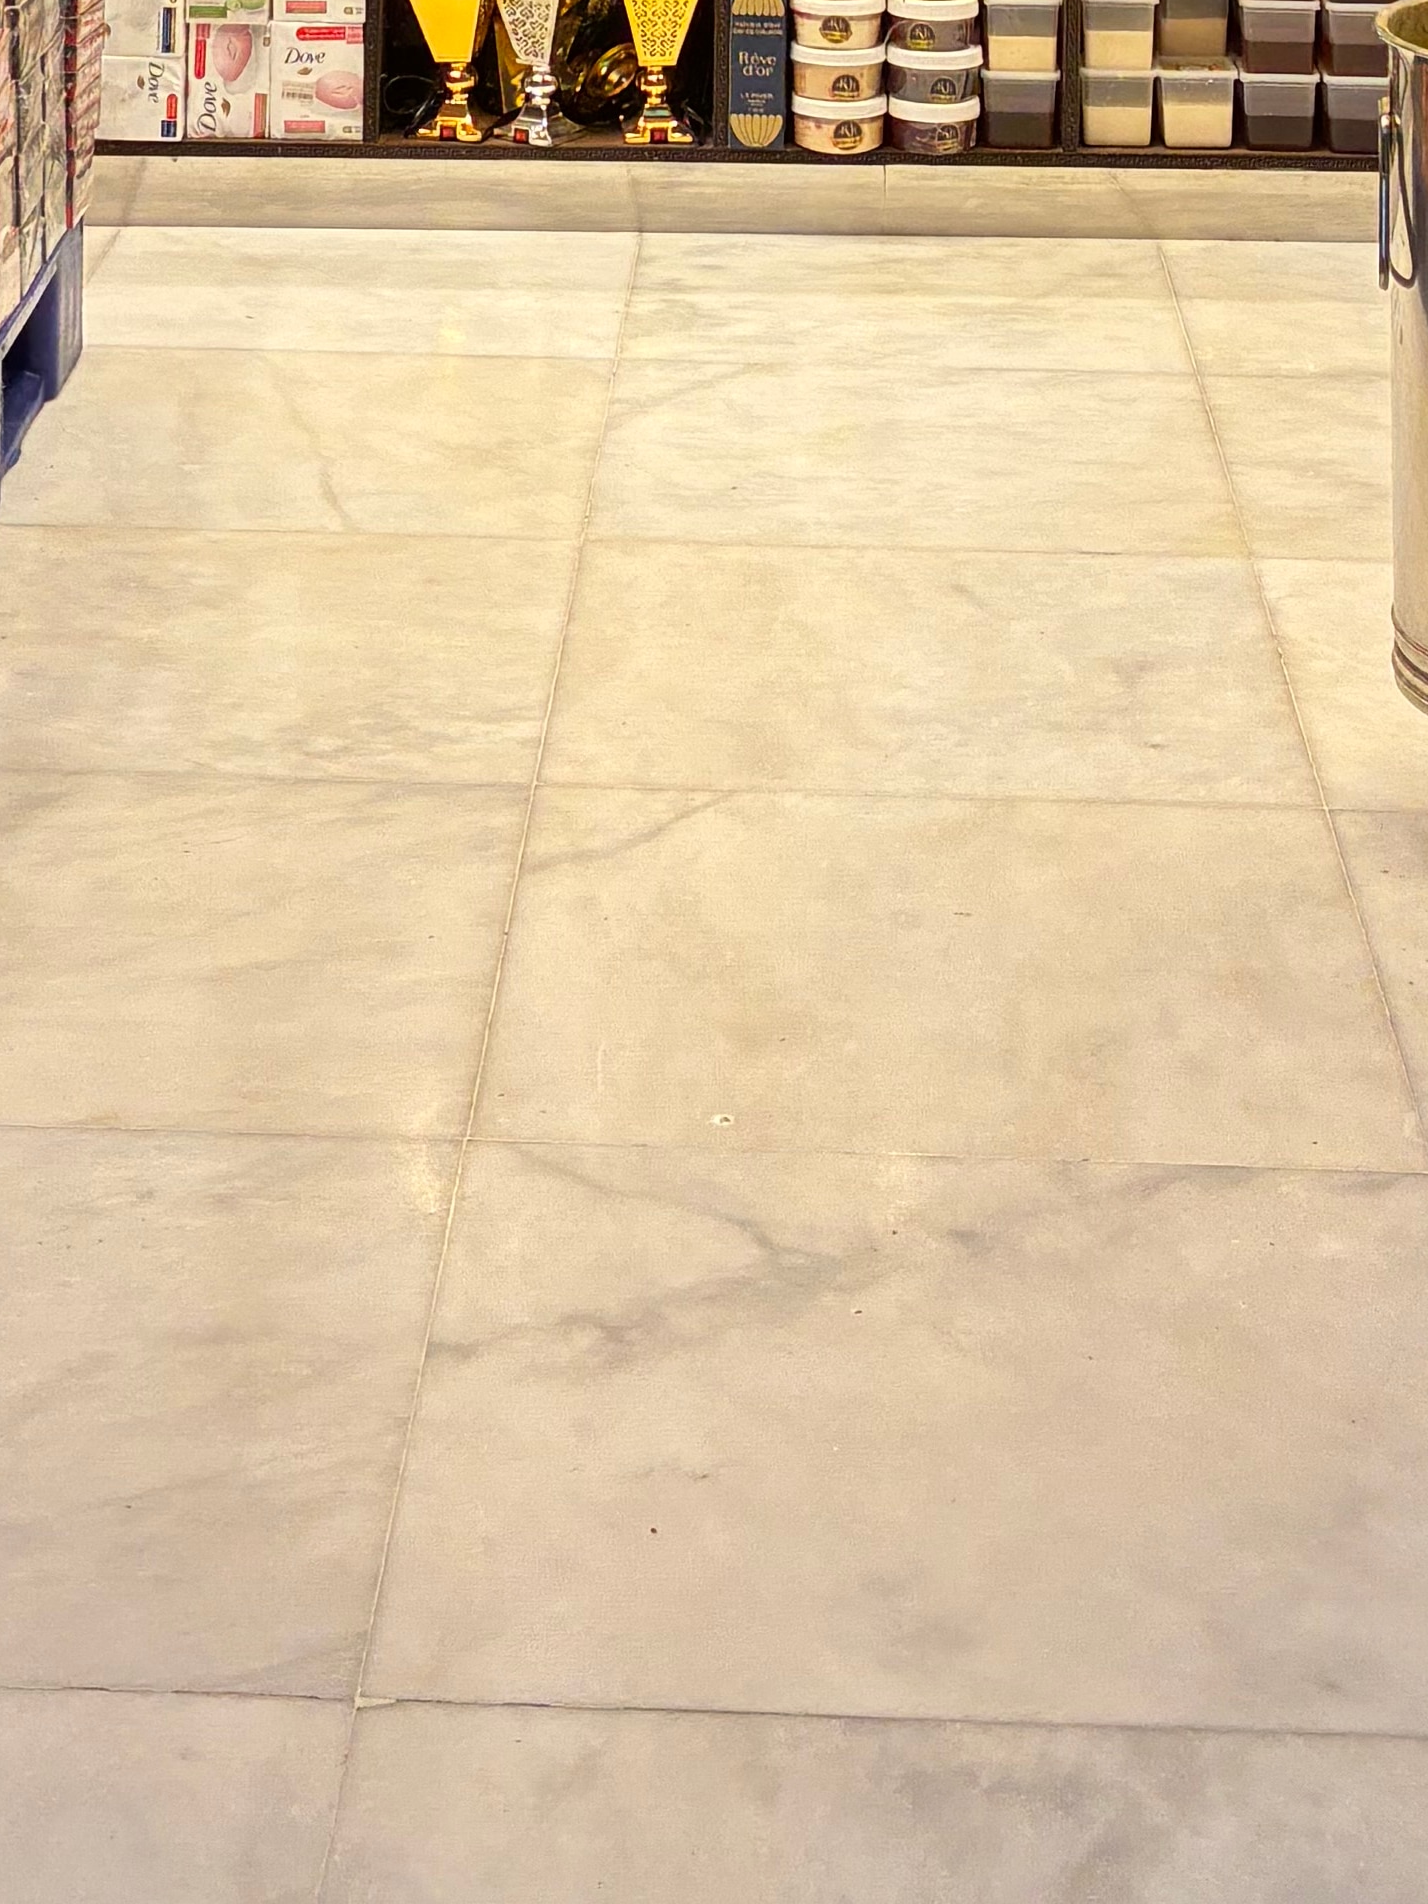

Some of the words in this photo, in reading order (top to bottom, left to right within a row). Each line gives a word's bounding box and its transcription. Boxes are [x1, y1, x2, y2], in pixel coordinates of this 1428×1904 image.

[284, 47, 326, 64] Dove
[148, 62, 165, 103] Dove
[197, 82, 217, 132] Dove
